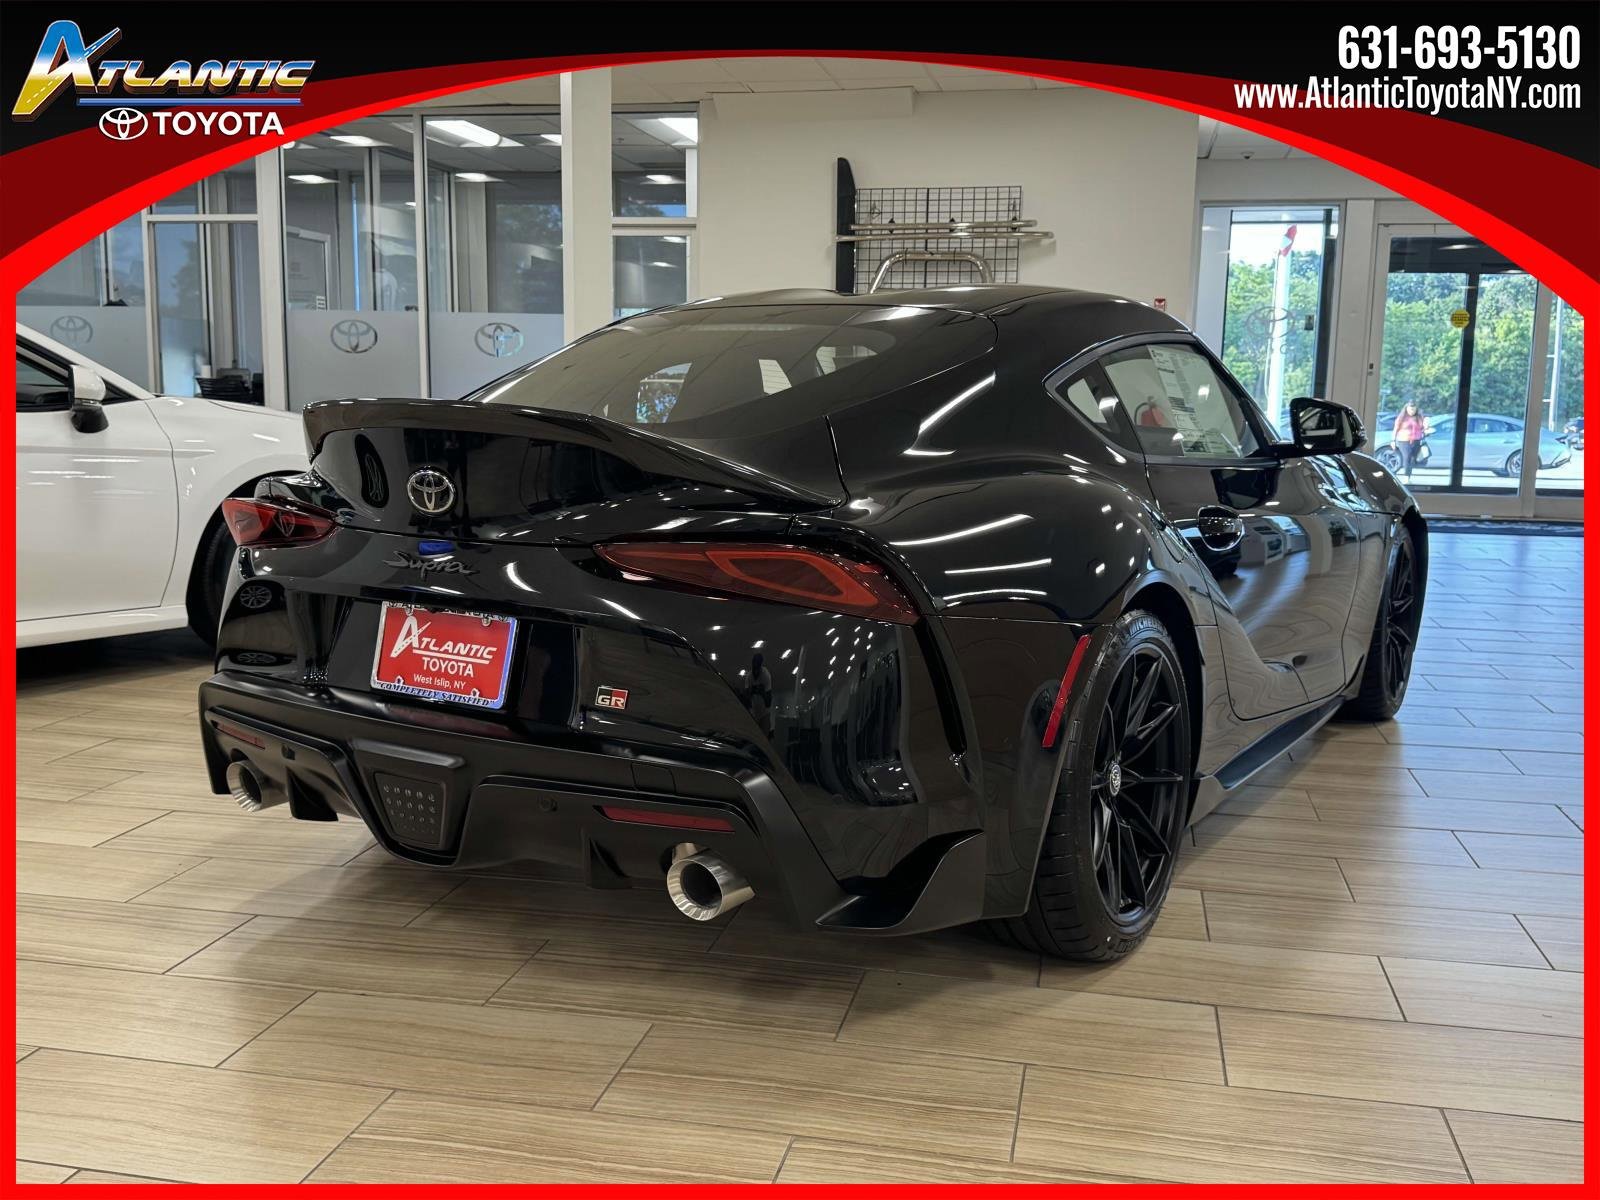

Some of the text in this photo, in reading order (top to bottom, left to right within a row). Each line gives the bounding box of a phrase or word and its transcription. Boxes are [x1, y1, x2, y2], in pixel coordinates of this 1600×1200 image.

[382, 550, 480, 582] Supra
[390, 615, 498, 660] ATLANTIC
[422, 657, 475, 678] TOYOTA
[413, 673, 467, 690] West Islip, NY
[598, 695, 624, 707] GR
